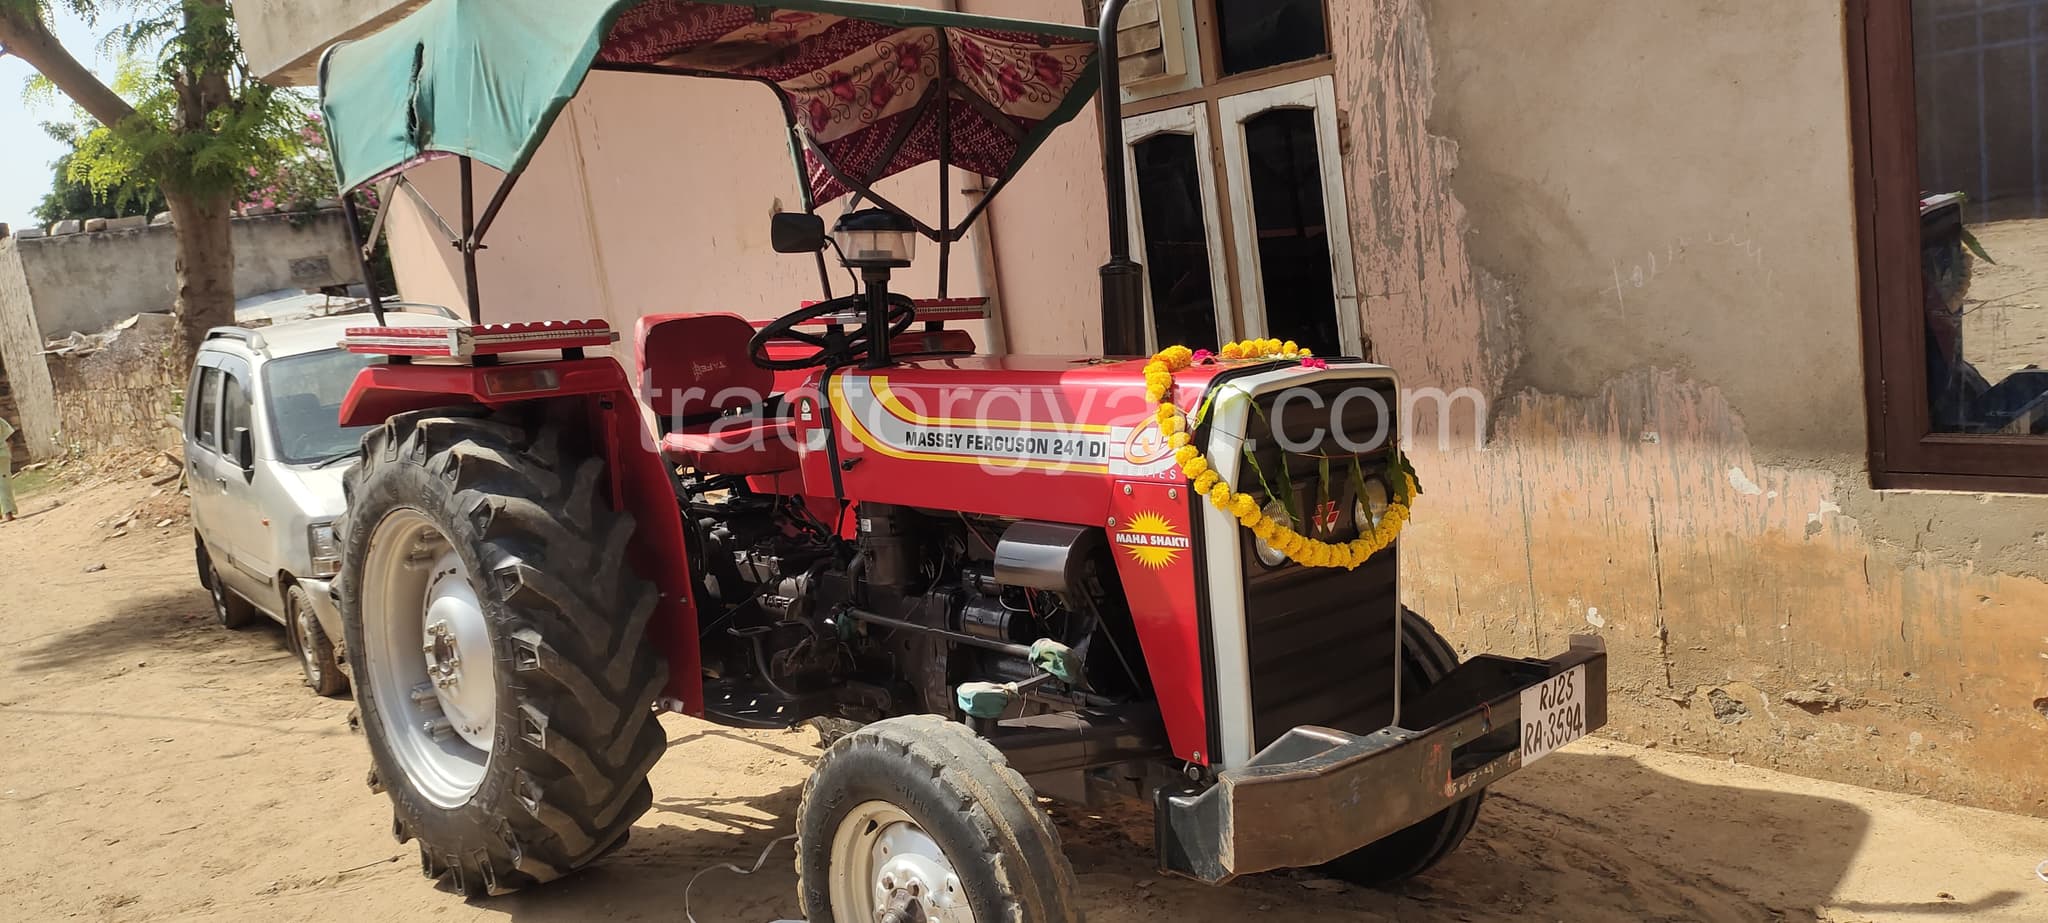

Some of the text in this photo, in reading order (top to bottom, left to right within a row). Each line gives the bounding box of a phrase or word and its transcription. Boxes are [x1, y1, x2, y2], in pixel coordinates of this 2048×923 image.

[905, 431, 1106, 458] MASSEY FERGUSON 241 DI
[1116, 533, 1189, 547] MAHA SHAKTI
[1539, 670, 1574, 711] RJ25
